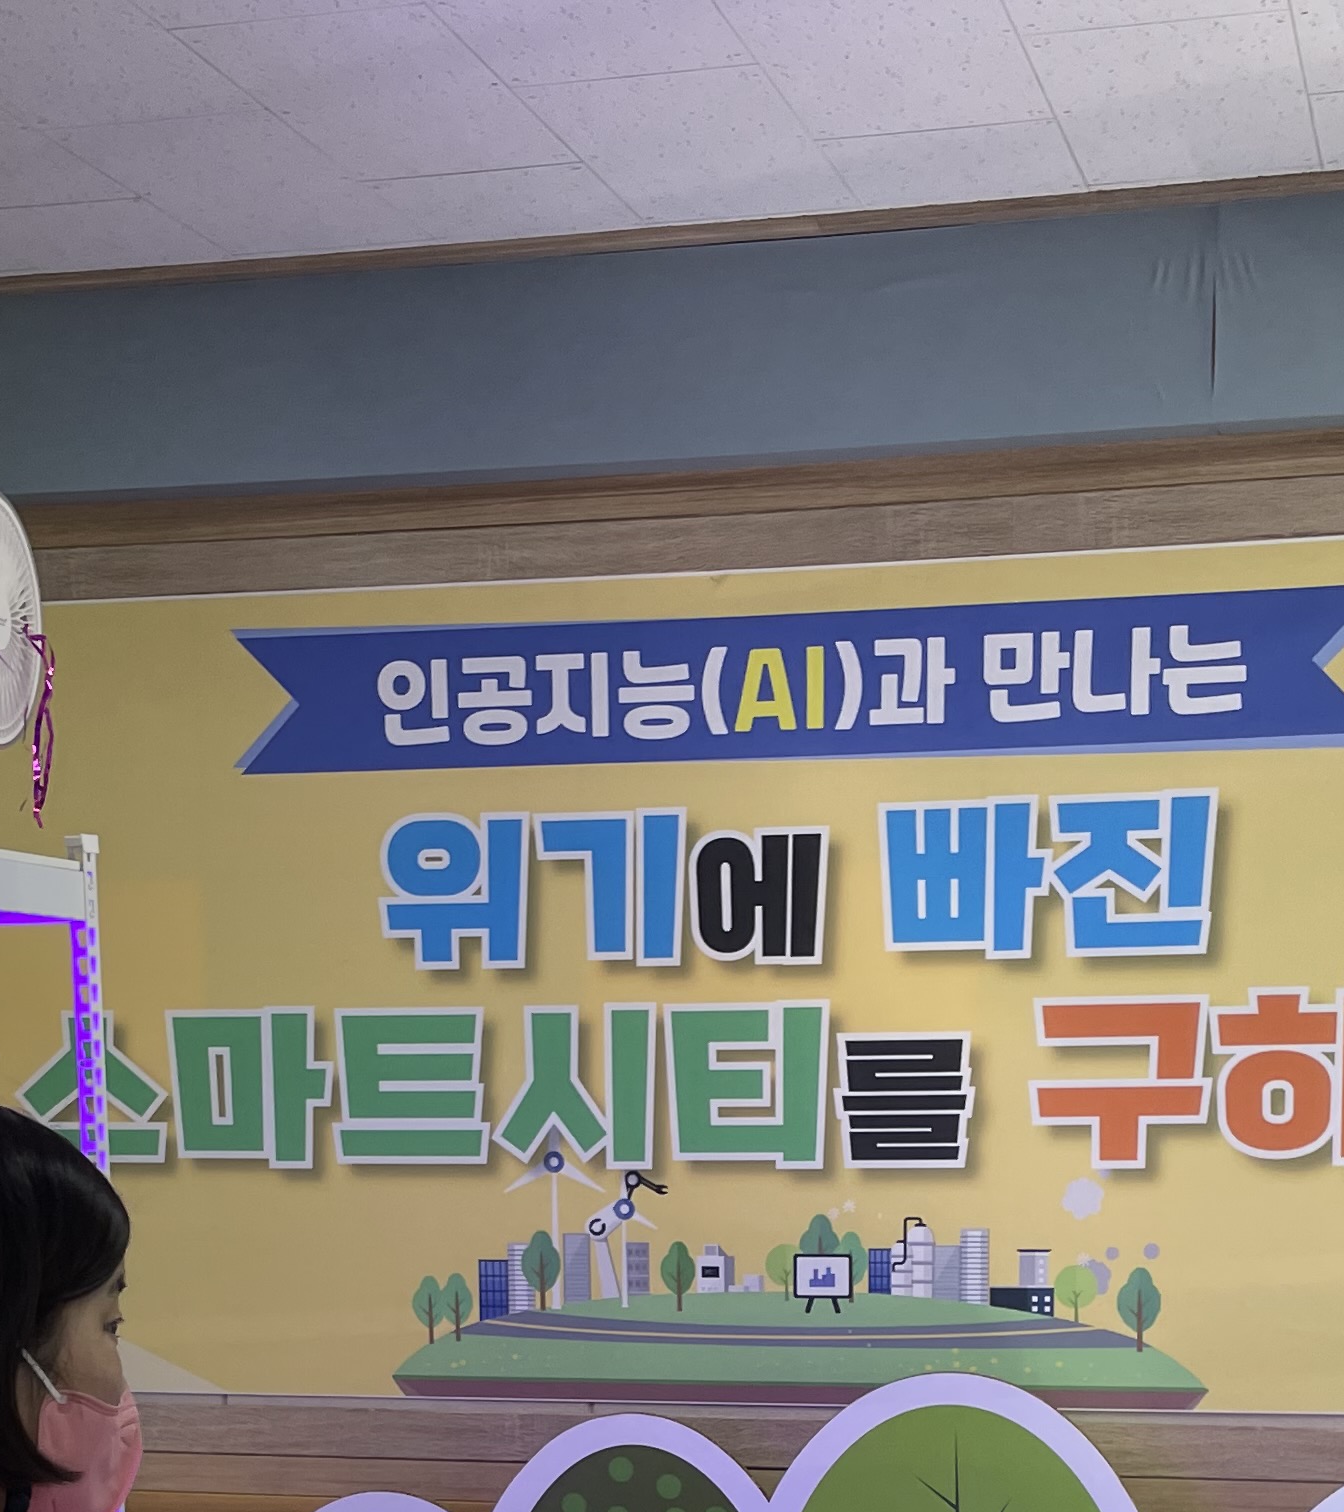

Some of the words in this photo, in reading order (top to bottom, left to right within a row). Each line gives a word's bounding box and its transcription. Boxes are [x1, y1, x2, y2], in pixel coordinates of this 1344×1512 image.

[376, 637, 955, 746] 인공지능(AI)과
[982, 623, 1248, 724] 만나는
[380, 806, 829, 969] 위기에
[877, 786, 1220, 960] 빠진
[16, 998, 975, 1171] 스마트시티를
